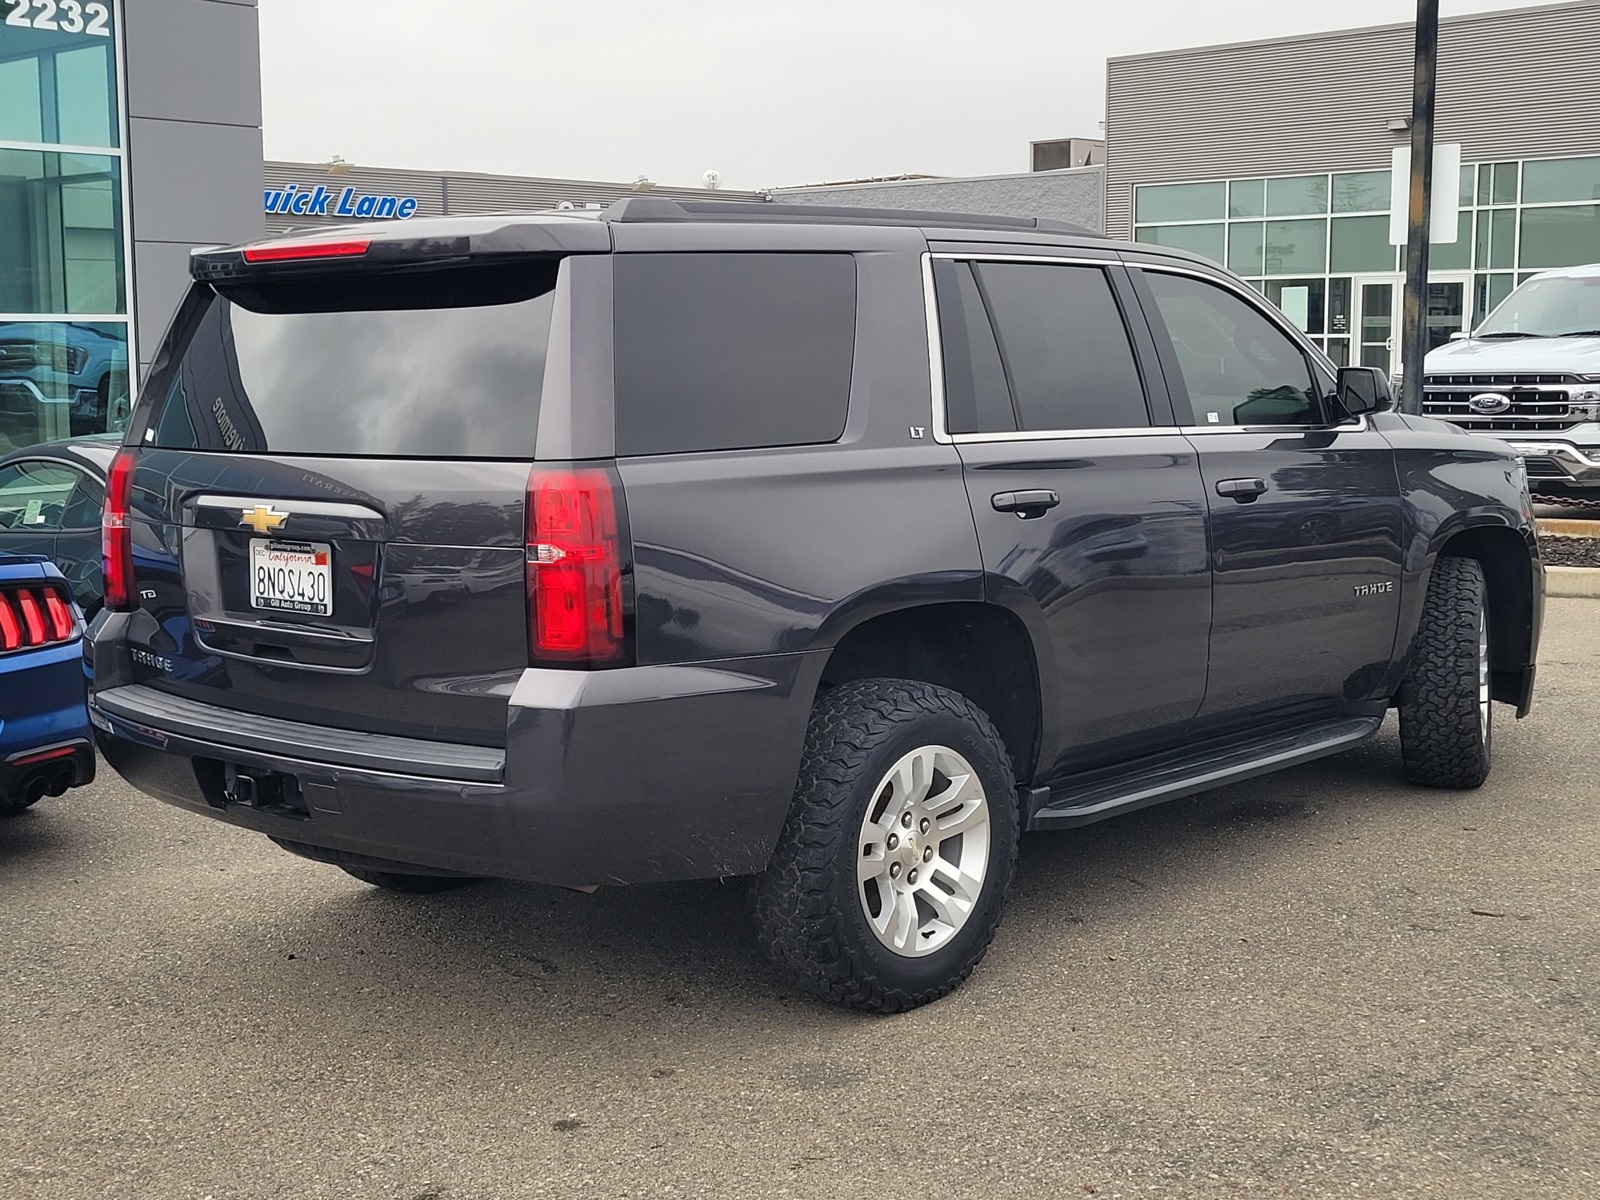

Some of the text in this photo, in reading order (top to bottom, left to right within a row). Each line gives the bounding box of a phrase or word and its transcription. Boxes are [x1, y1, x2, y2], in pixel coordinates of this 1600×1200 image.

[5, 0, 110, 36] 2232
[264, 184, 418, 220] uick Lane
[909, 426, 925, 439] LT
[255, 549, 265, 557] DEC
[268, 551, 314, 567] California
[257, 565, 326, 602] 8NQS430
[1353, 581, 1393, 597] TAHOE
[270, 599, 311, 611] Gill Auto Group
[130, 648, 174, 672] TAHOE
